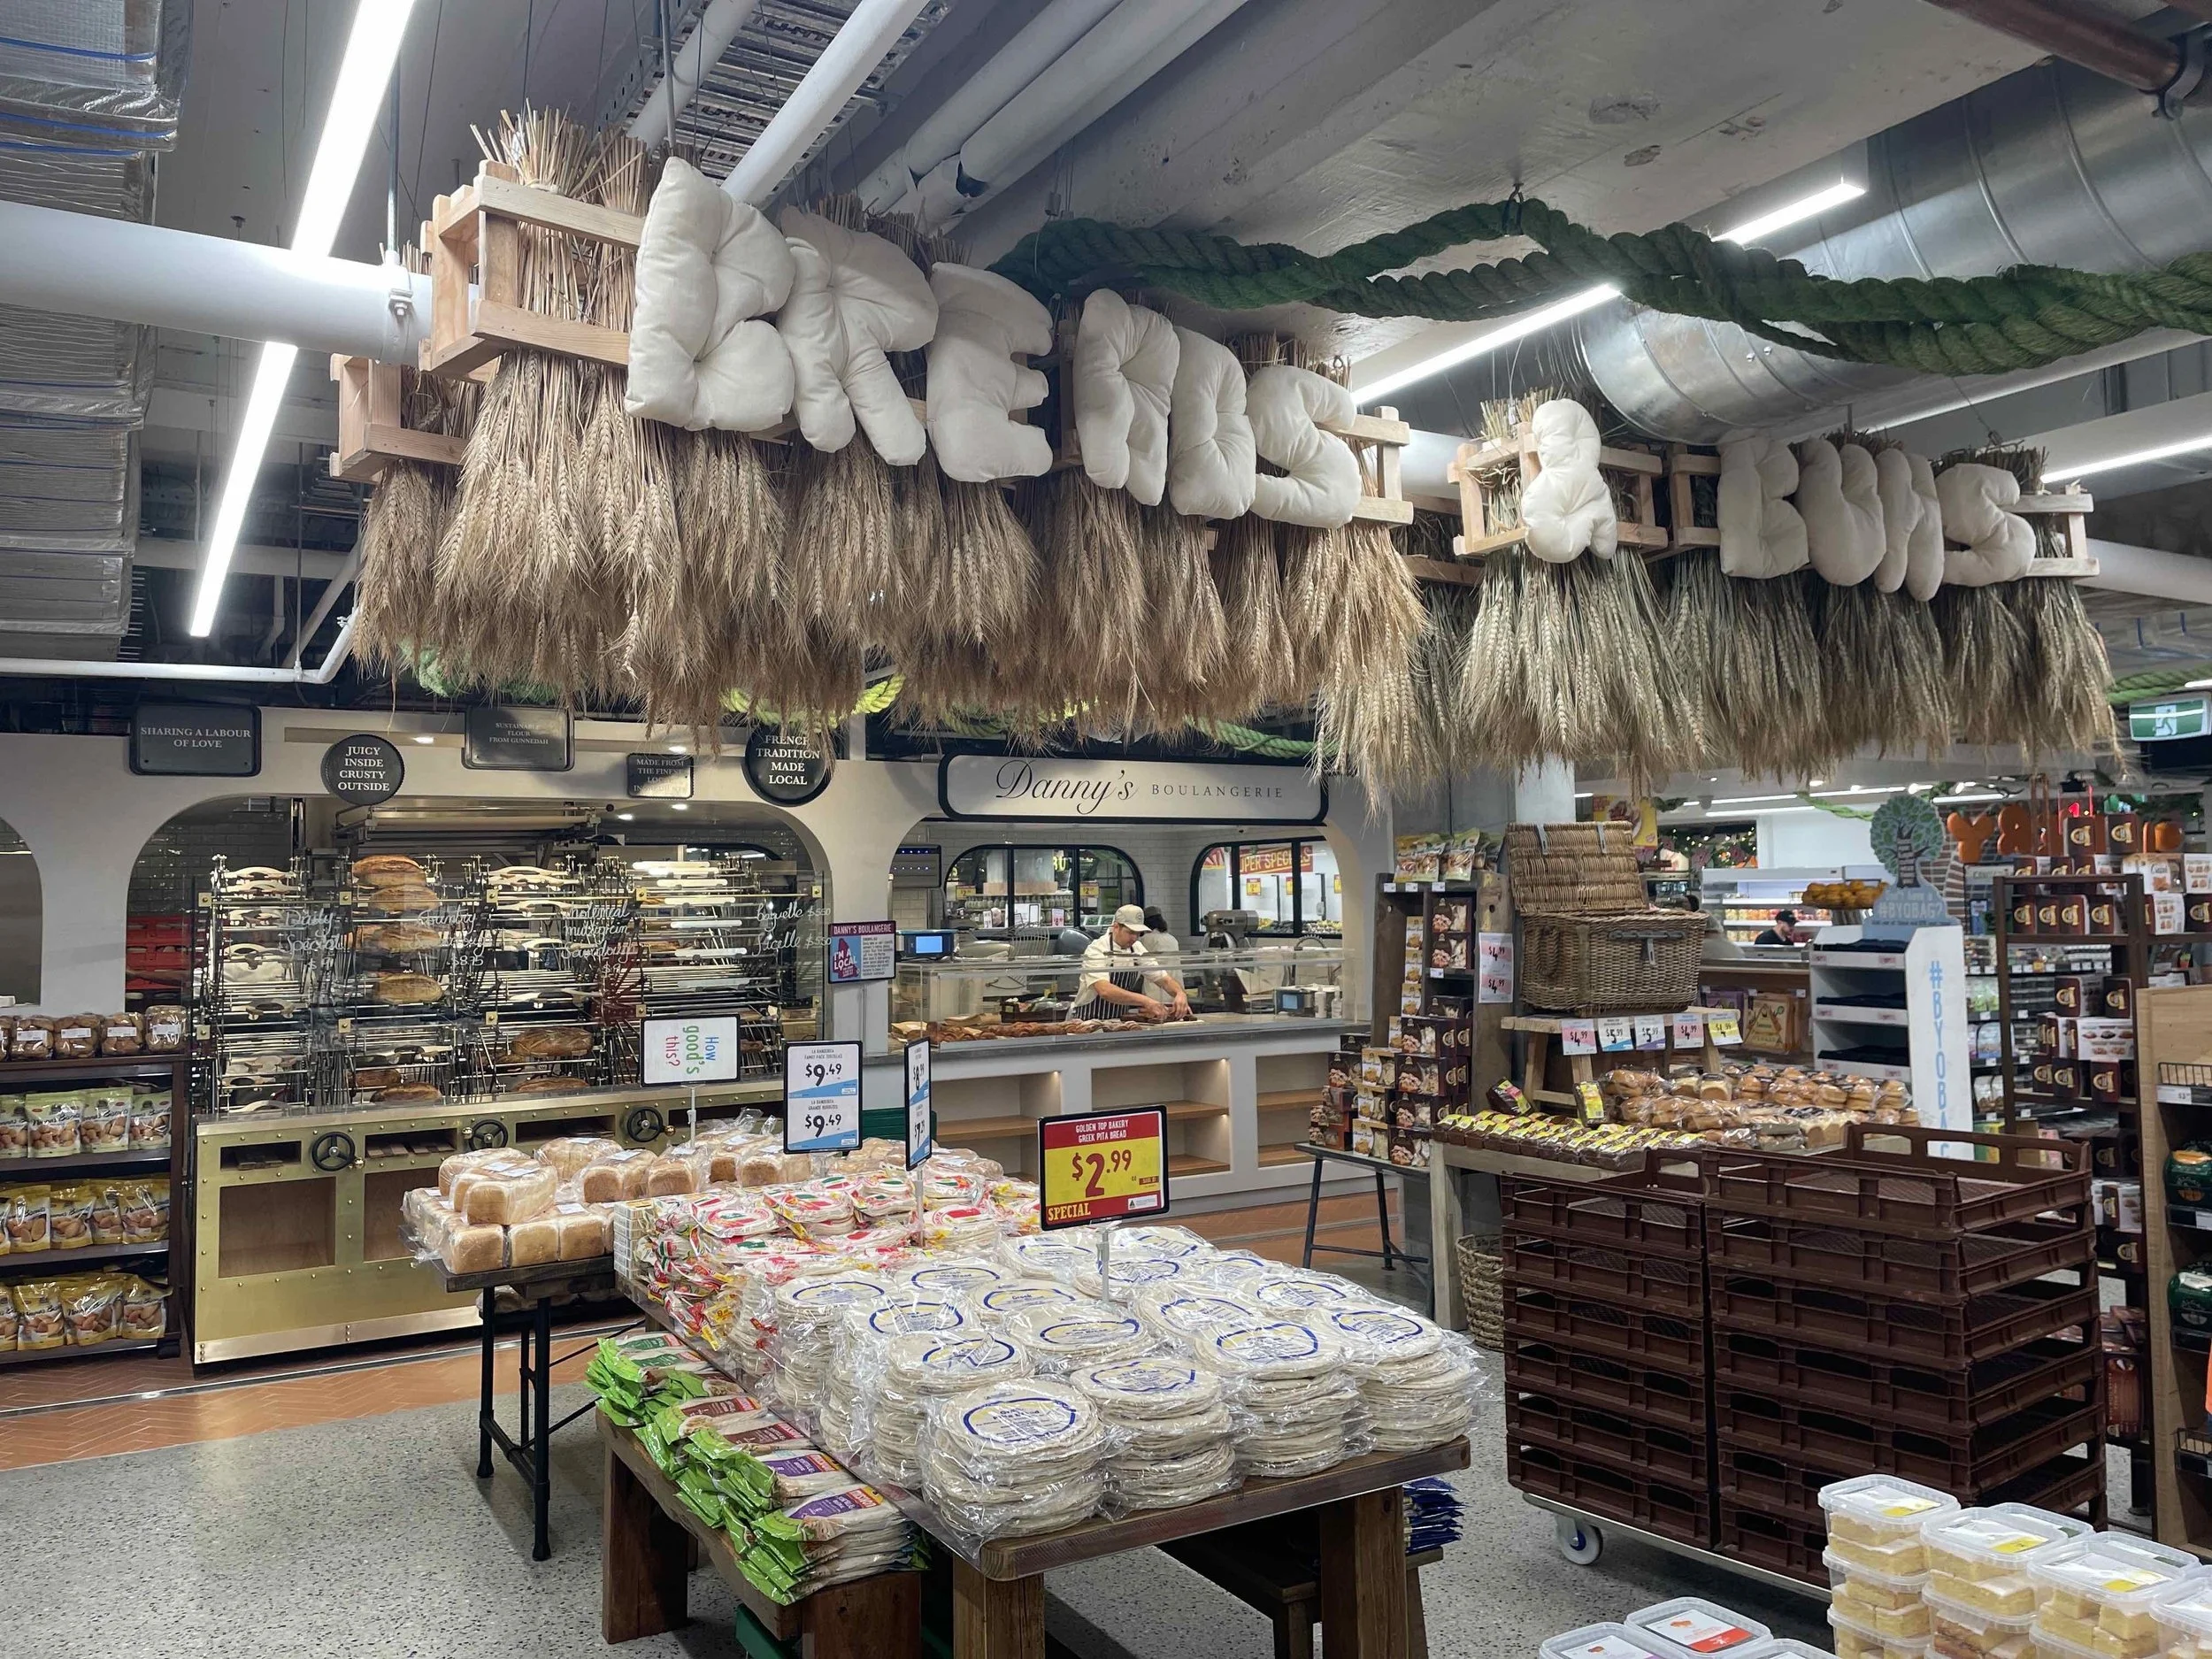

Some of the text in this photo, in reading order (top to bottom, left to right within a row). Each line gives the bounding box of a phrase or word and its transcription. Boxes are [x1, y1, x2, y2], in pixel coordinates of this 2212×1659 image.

[141, 727, 193, 736] SHARING
[205, 728, 251, 738] LABOUR
[173, 739, 223, 749] OF LOVE
[345, 746, 381, 757] JUICY
[756, 748, 820, 759] TRADITION
[344, 757, 384, 768] INSIDE
[771, 762, 805, 772] MADE
[339, 770, 386, 780] CRUSTY
[768, 774, 808, 786] LOCAL
[337, 781, 390, 792] OUTSIDE
[995, 759, 1283, 815] Danny's BOULANGERIE
[280, 908, 334, 938] Daily
[833, 925, 857, 935] DANNY'S
[833, 956, 857, 972] LOCAL
[665, 1035, 680, 1066] this?
[682, 1025, 705, 1075] good's
[705, 1036, 719, 1061] How
[805, 1064, 842, 1087] $9.49
[804, 1114, 841, 1139] $9.49
[1075, 1119, 1129, 1133] GOLDEN TOP BAKERY
[1079, 1130, 1127, 1143] GREEK PITA BREAD
[1071, 1149, 1132, 1198] $2.99
[1048, 1203, 1091, 1222] SPECIAL
